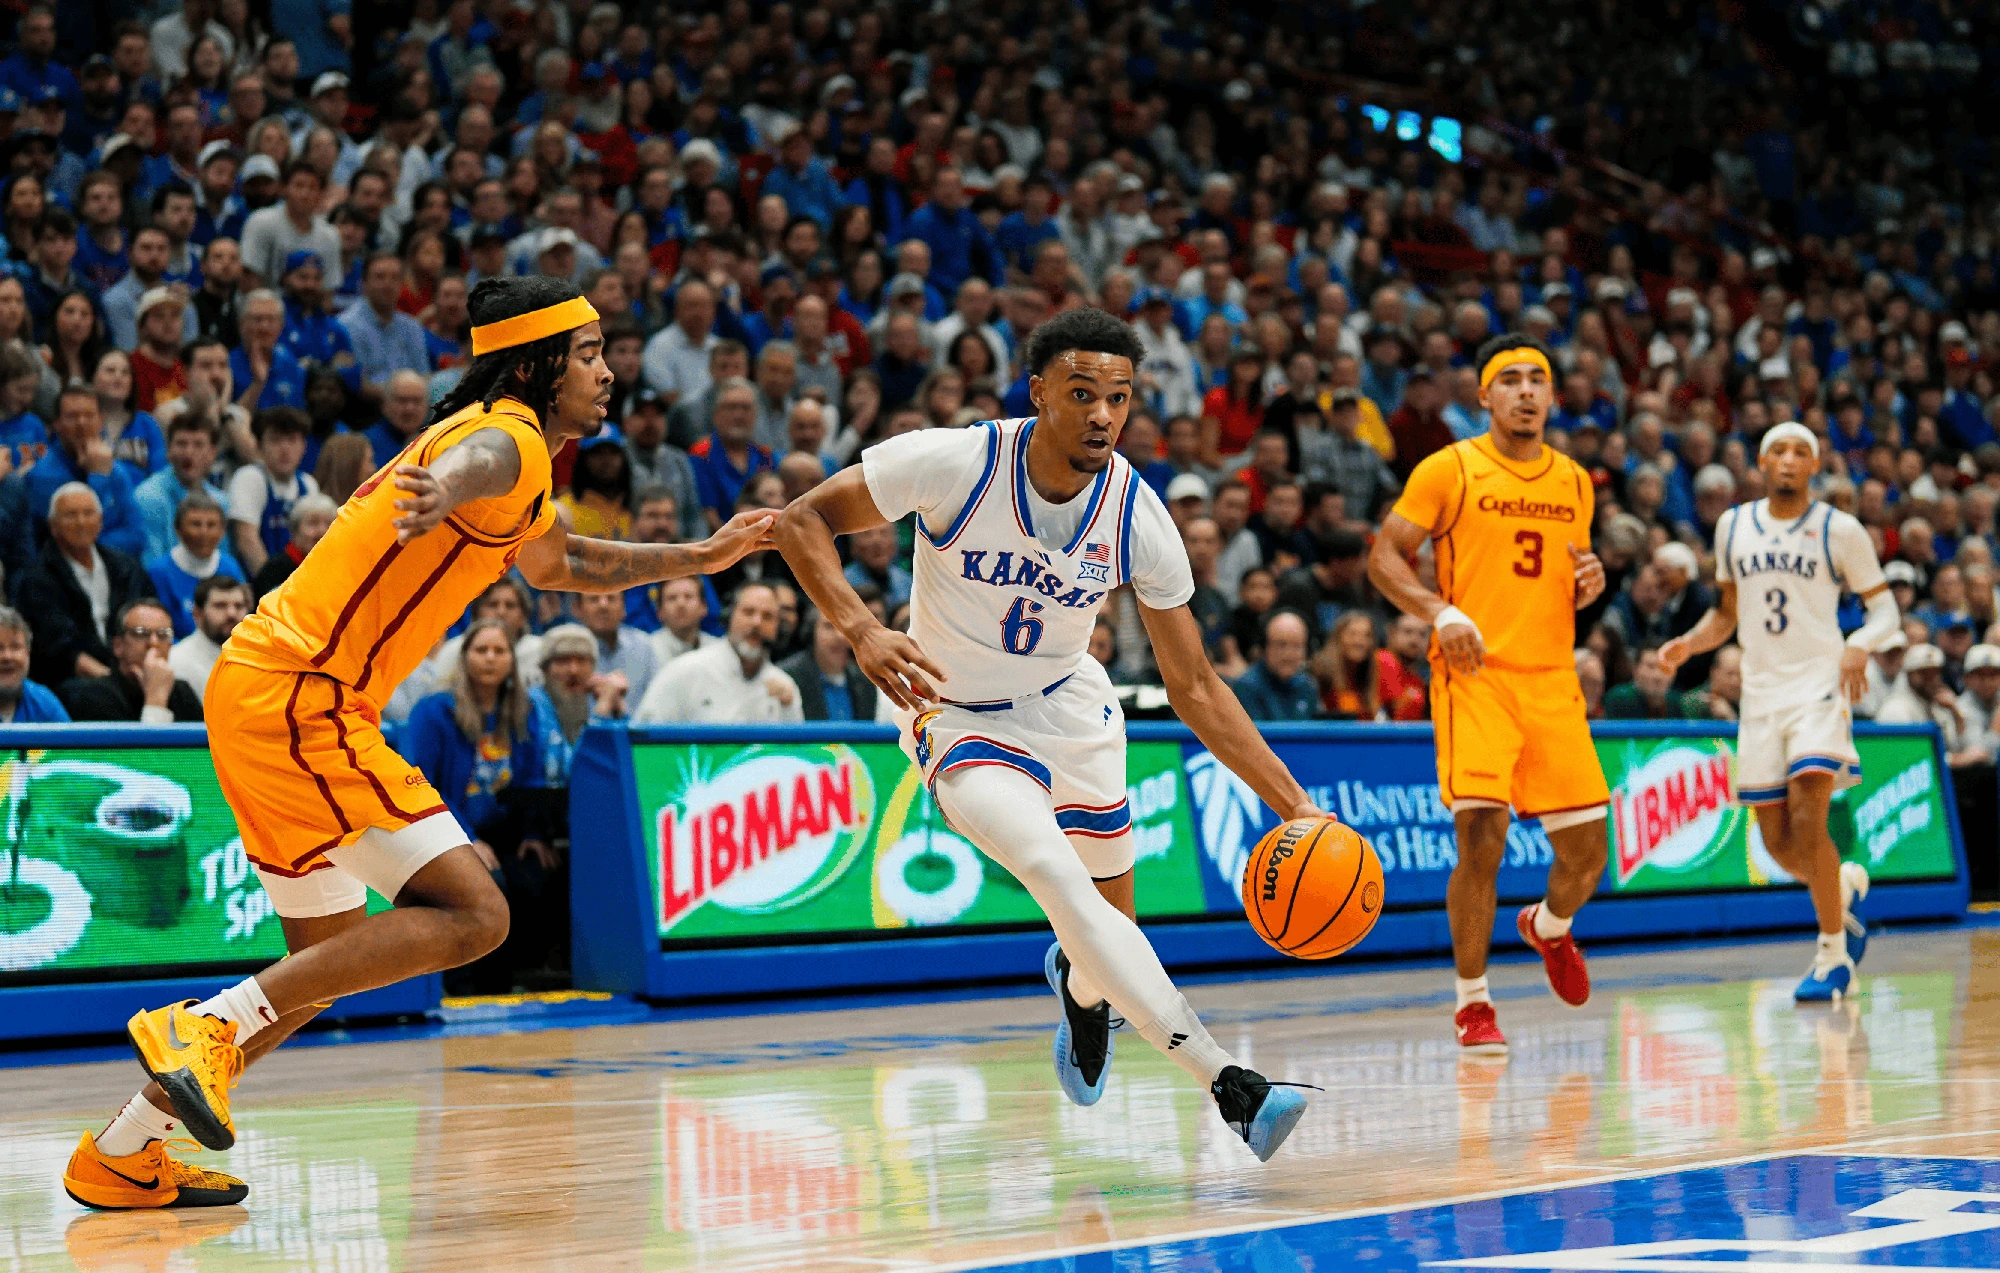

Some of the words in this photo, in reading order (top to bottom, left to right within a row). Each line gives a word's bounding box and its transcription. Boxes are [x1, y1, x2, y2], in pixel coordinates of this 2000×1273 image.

[1478, 495, 1576, 523] Cyclones
[960, 550, 1106, 609] KANSAS
[1513, 530, 1543, 579] 3
[1737, 551, 1817, 578] KANSAS
[1000, 595, 1045, 656] 6
[1765, 588, 1788, 635] 3
[660, 760, 852, 926] LIBMAN
[1614, 755, 1731, 878] LIBMAN
[1262, 822, 1318, 902] Wilson
